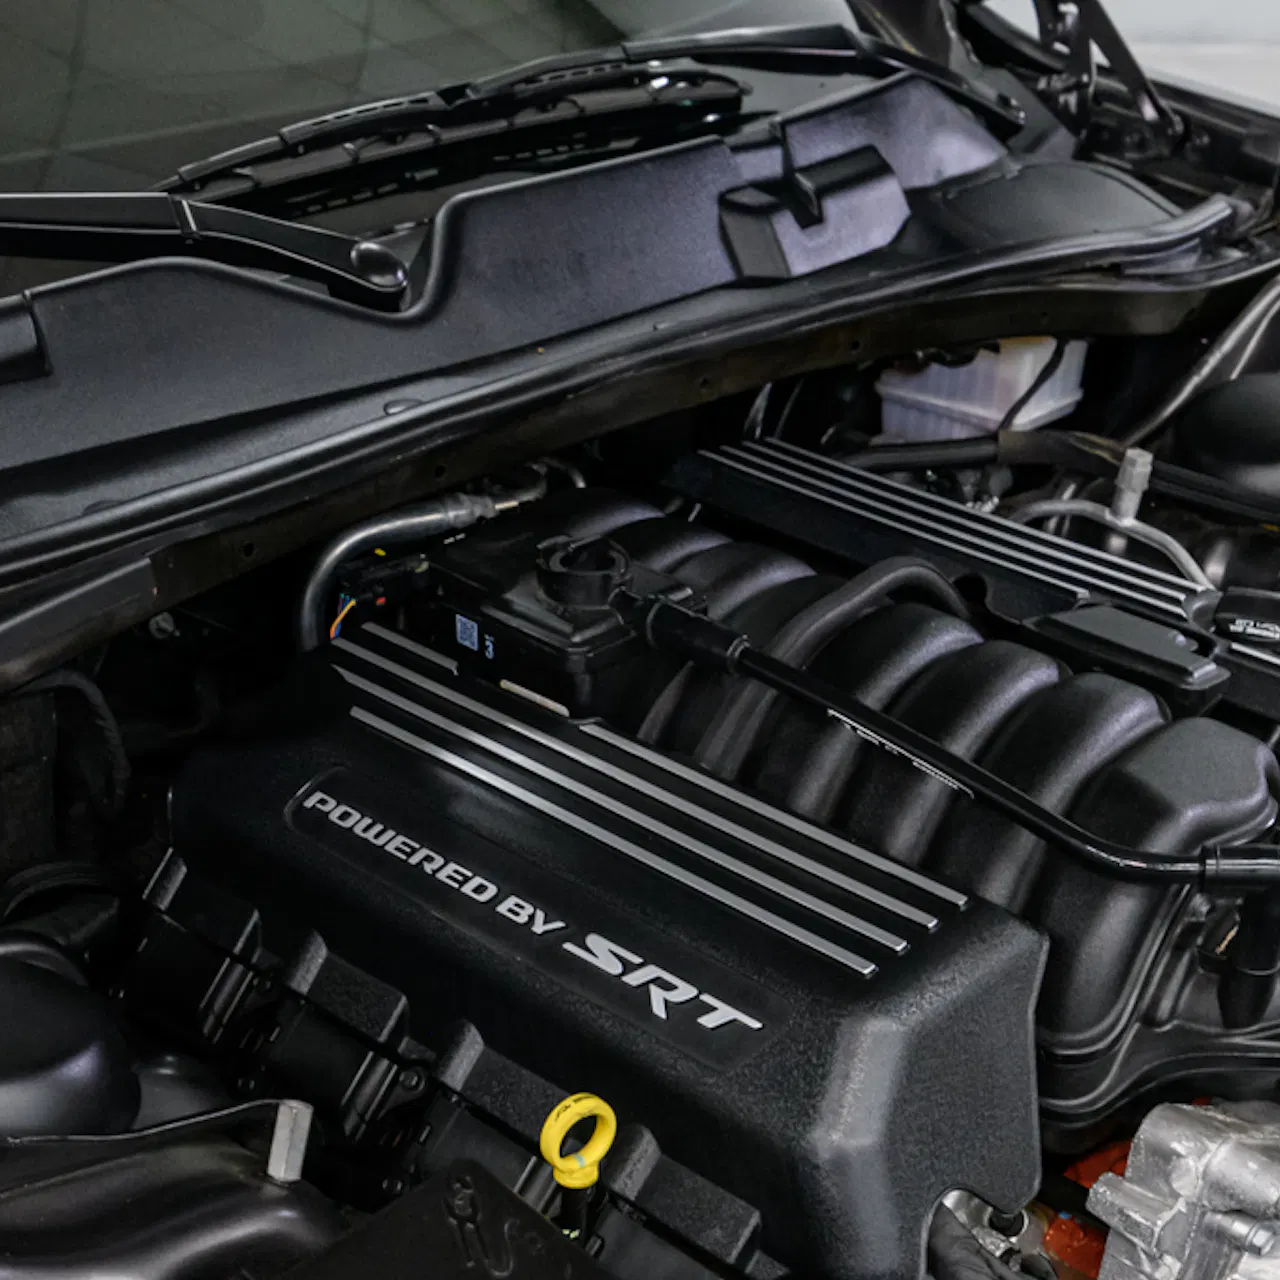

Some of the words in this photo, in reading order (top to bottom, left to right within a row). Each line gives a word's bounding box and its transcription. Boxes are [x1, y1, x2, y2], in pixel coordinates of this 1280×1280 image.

[302, 790, 499, 903] POWERED
[495, 894, 567, 935] BY
[562, 932, 764, 1030] SRT
